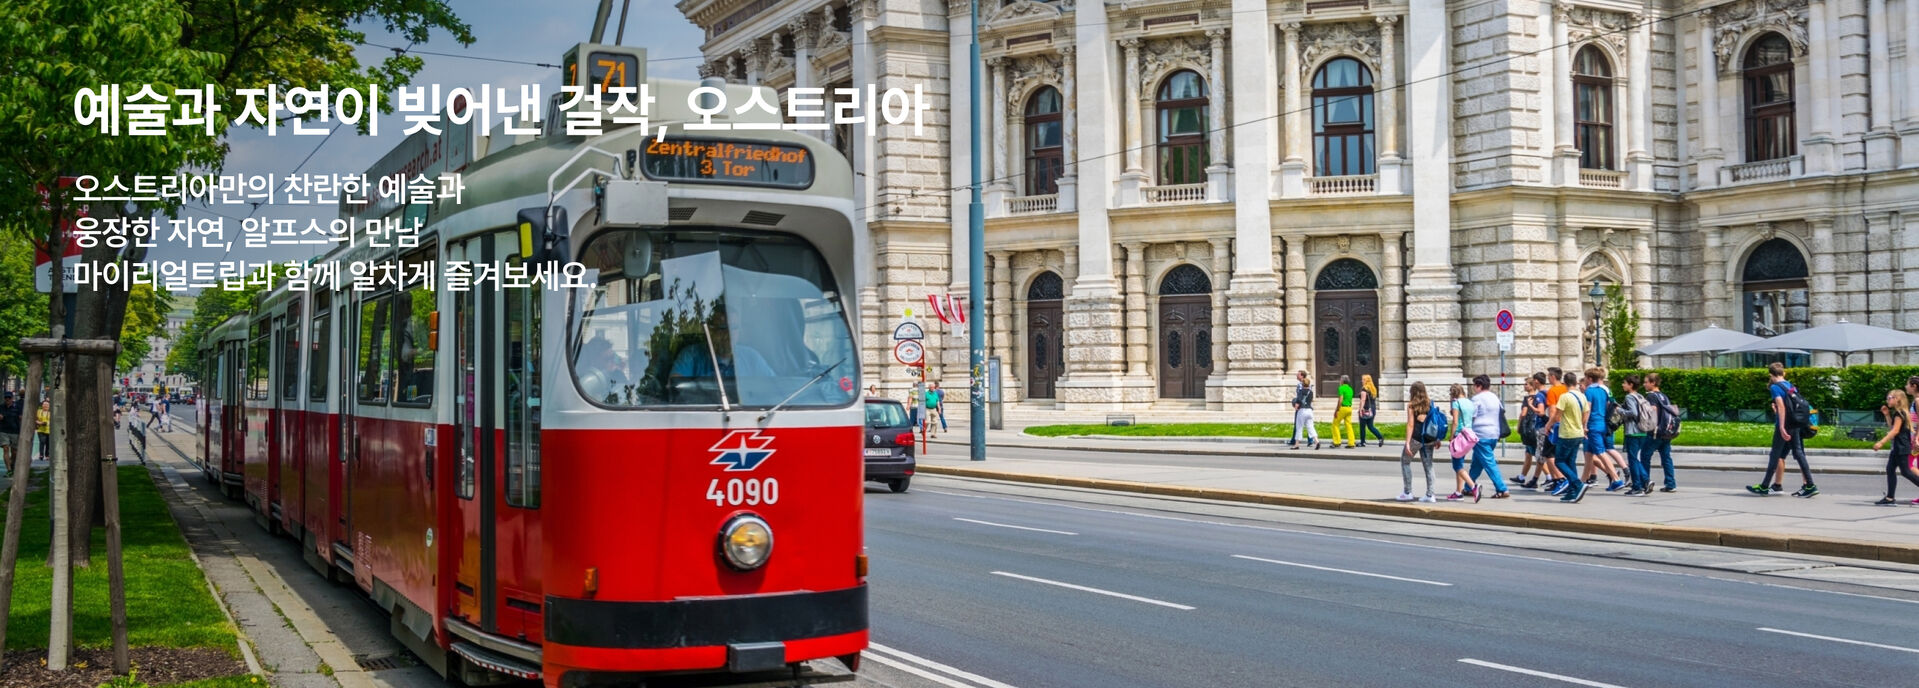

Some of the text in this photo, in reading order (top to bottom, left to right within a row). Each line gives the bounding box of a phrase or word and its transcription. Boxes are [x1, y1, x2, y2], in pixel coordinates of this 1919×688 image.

[598, 60, 626, 93] 71
[646, 138, 808, 164] Zentralfriedhof
[701, 159, 756, 177] 3. Tor
[706, 477, 779, 507] 4090
